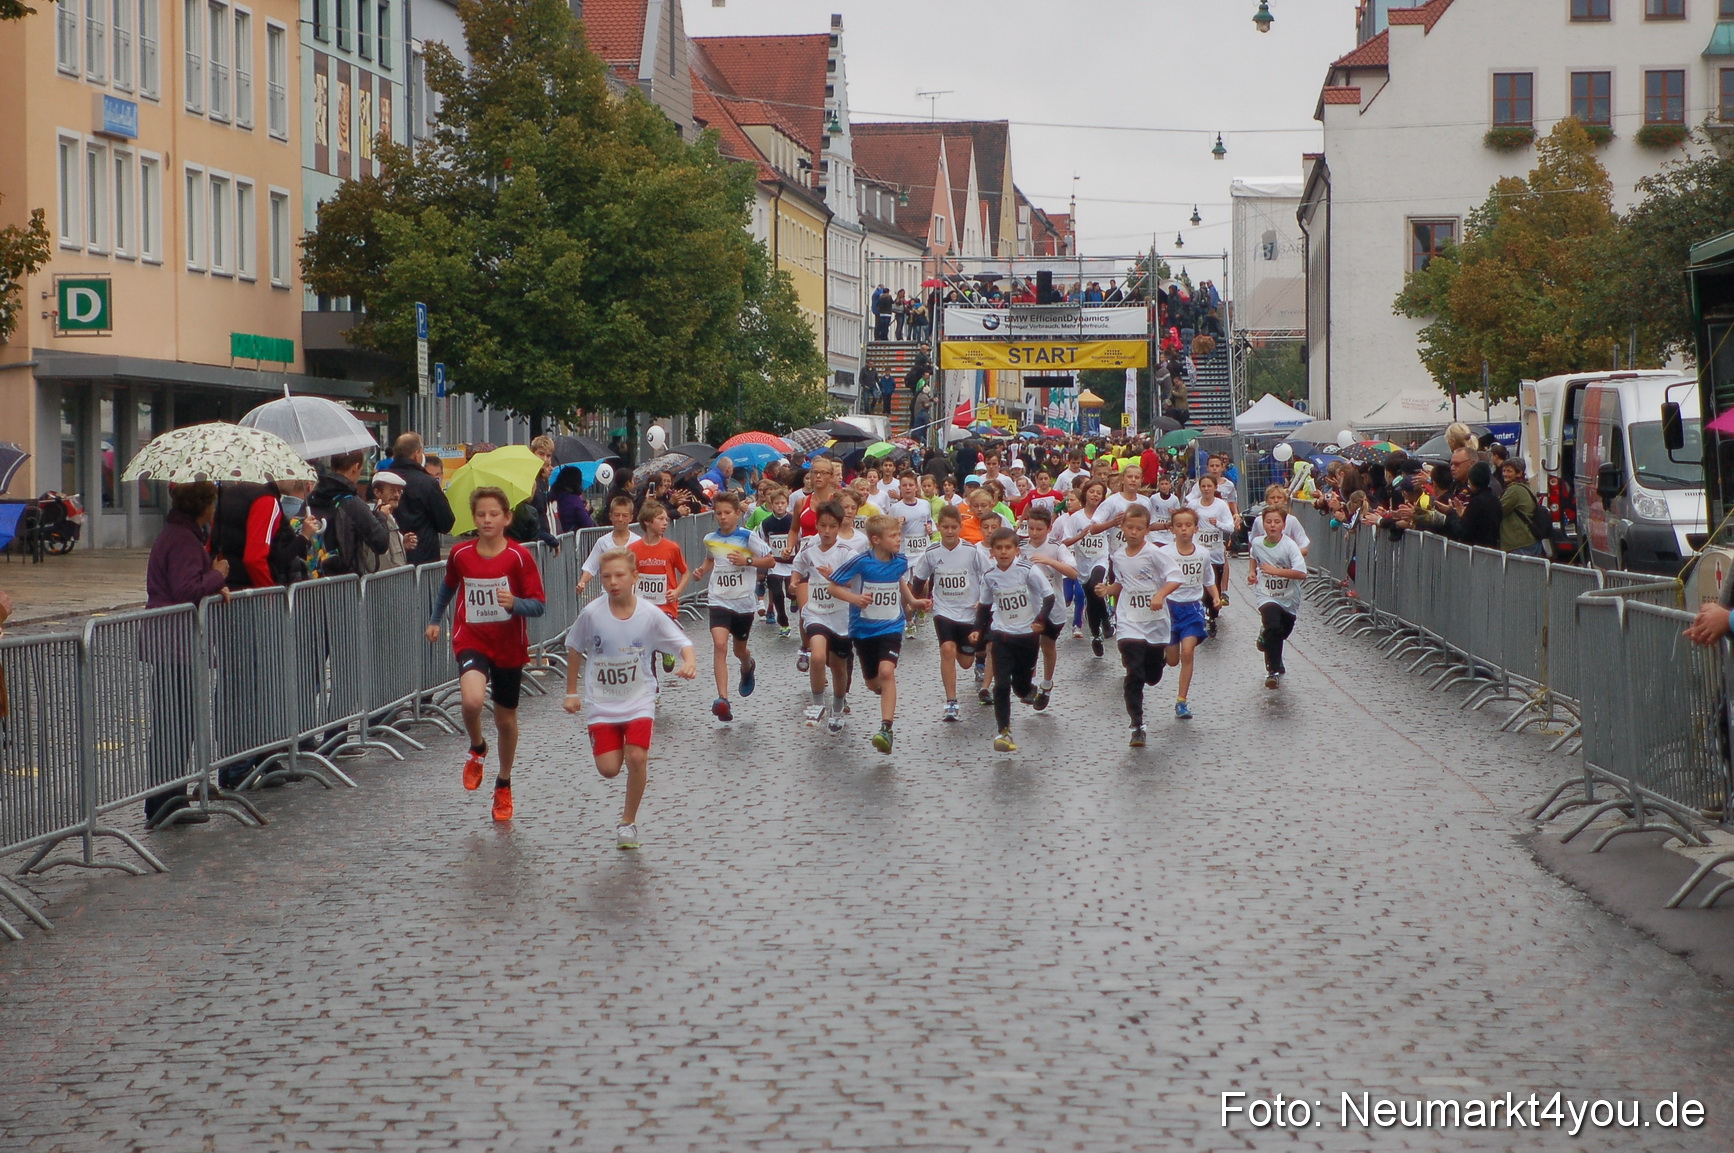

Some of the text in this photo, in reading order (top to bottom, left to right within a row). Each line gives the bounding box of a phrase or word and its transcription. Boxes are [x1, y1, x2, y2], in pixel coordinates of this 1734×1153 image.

[67, 287, 101, 322] D
[1030, 314, 1110, 323] EfficientDynamics
[1008, 347, 1079, 364] START
[907, 538, 927, 549] 4039
[1080, 539, 1103, 548] 4045
[717, 574, 743, 587] 4061
[939, 577, 966, 589] 4008
[1265, 579, 1290, 590] 4037
[999, 594, 1027, 611] 4030
[597, 665, 637, 685] 4057
